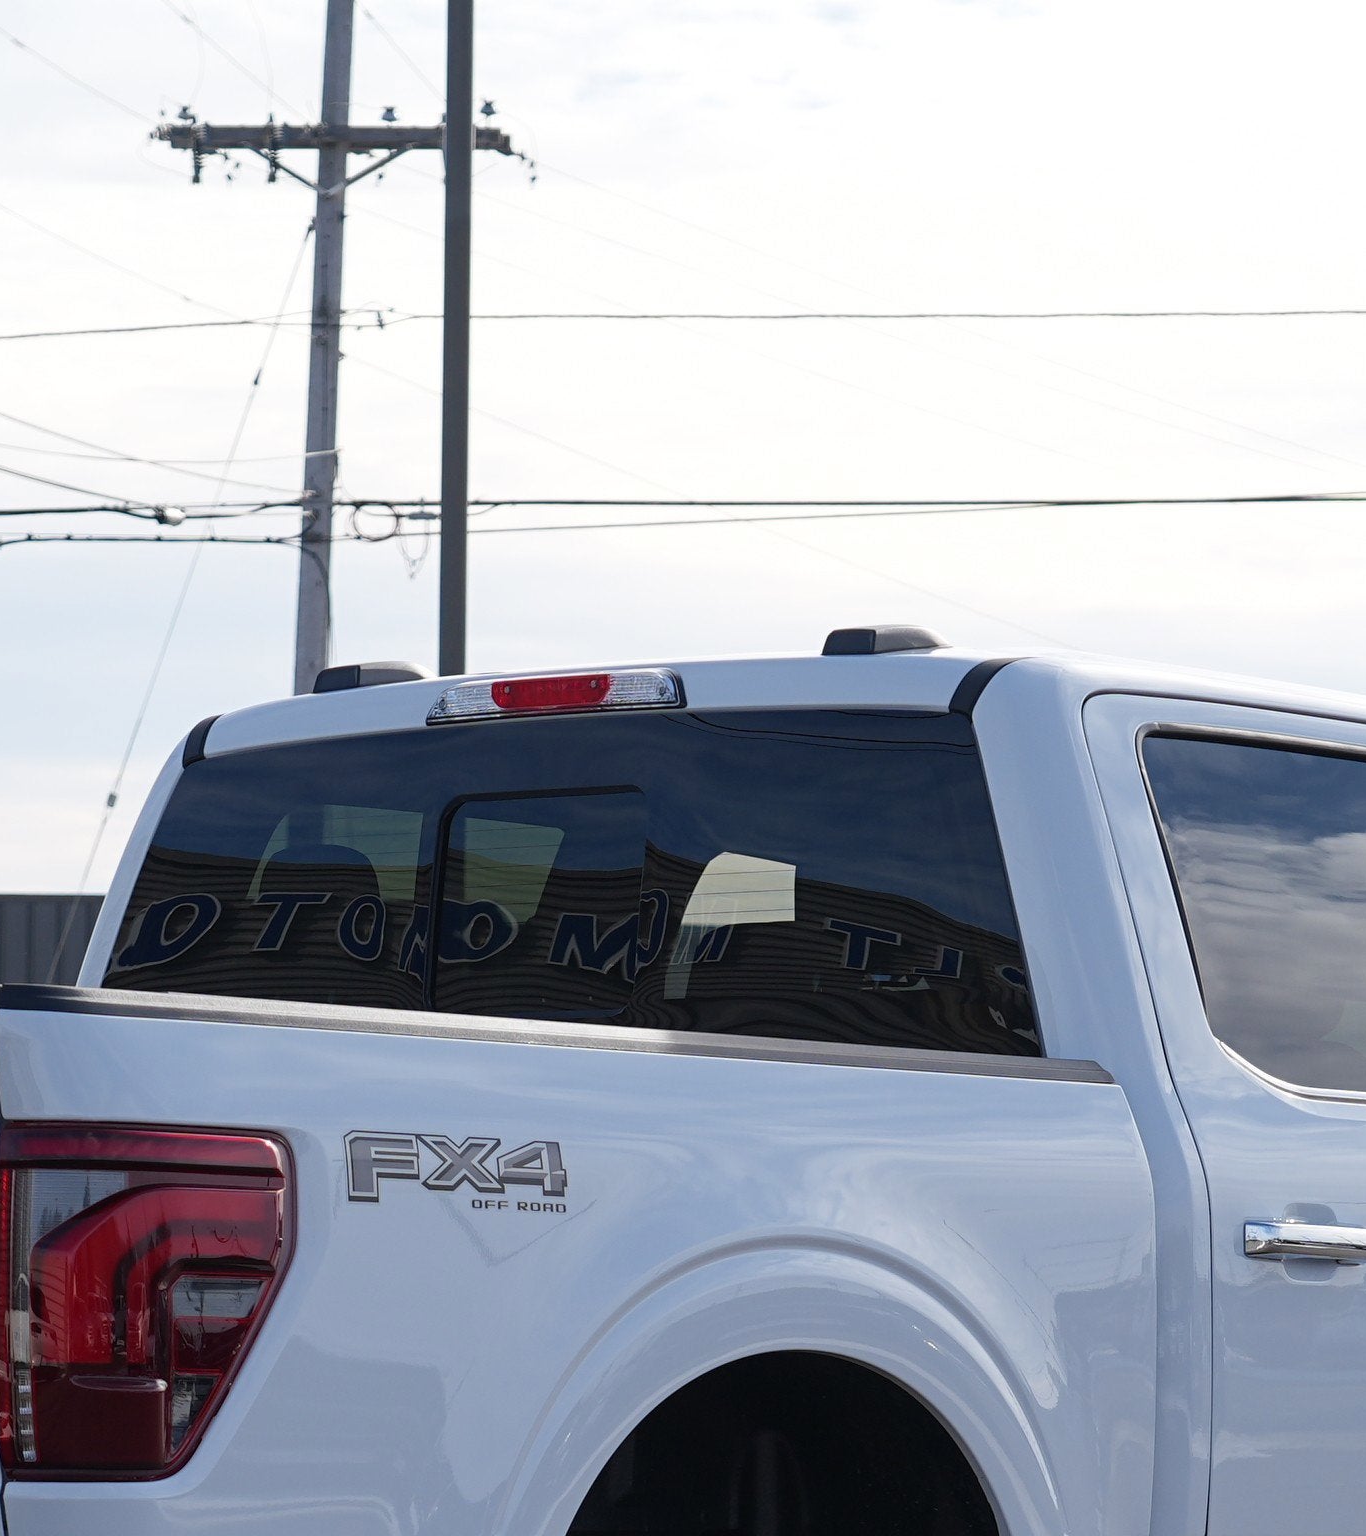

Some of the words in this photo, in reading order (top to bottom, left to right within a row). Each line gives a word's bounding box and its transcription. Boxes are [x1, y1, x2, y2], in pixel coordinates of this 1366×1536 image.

[343, 1130, 567, 1202] FX4
[471, 1199, 509, 1210] OFF
[517, 1201, 567, 1213] ROAD
